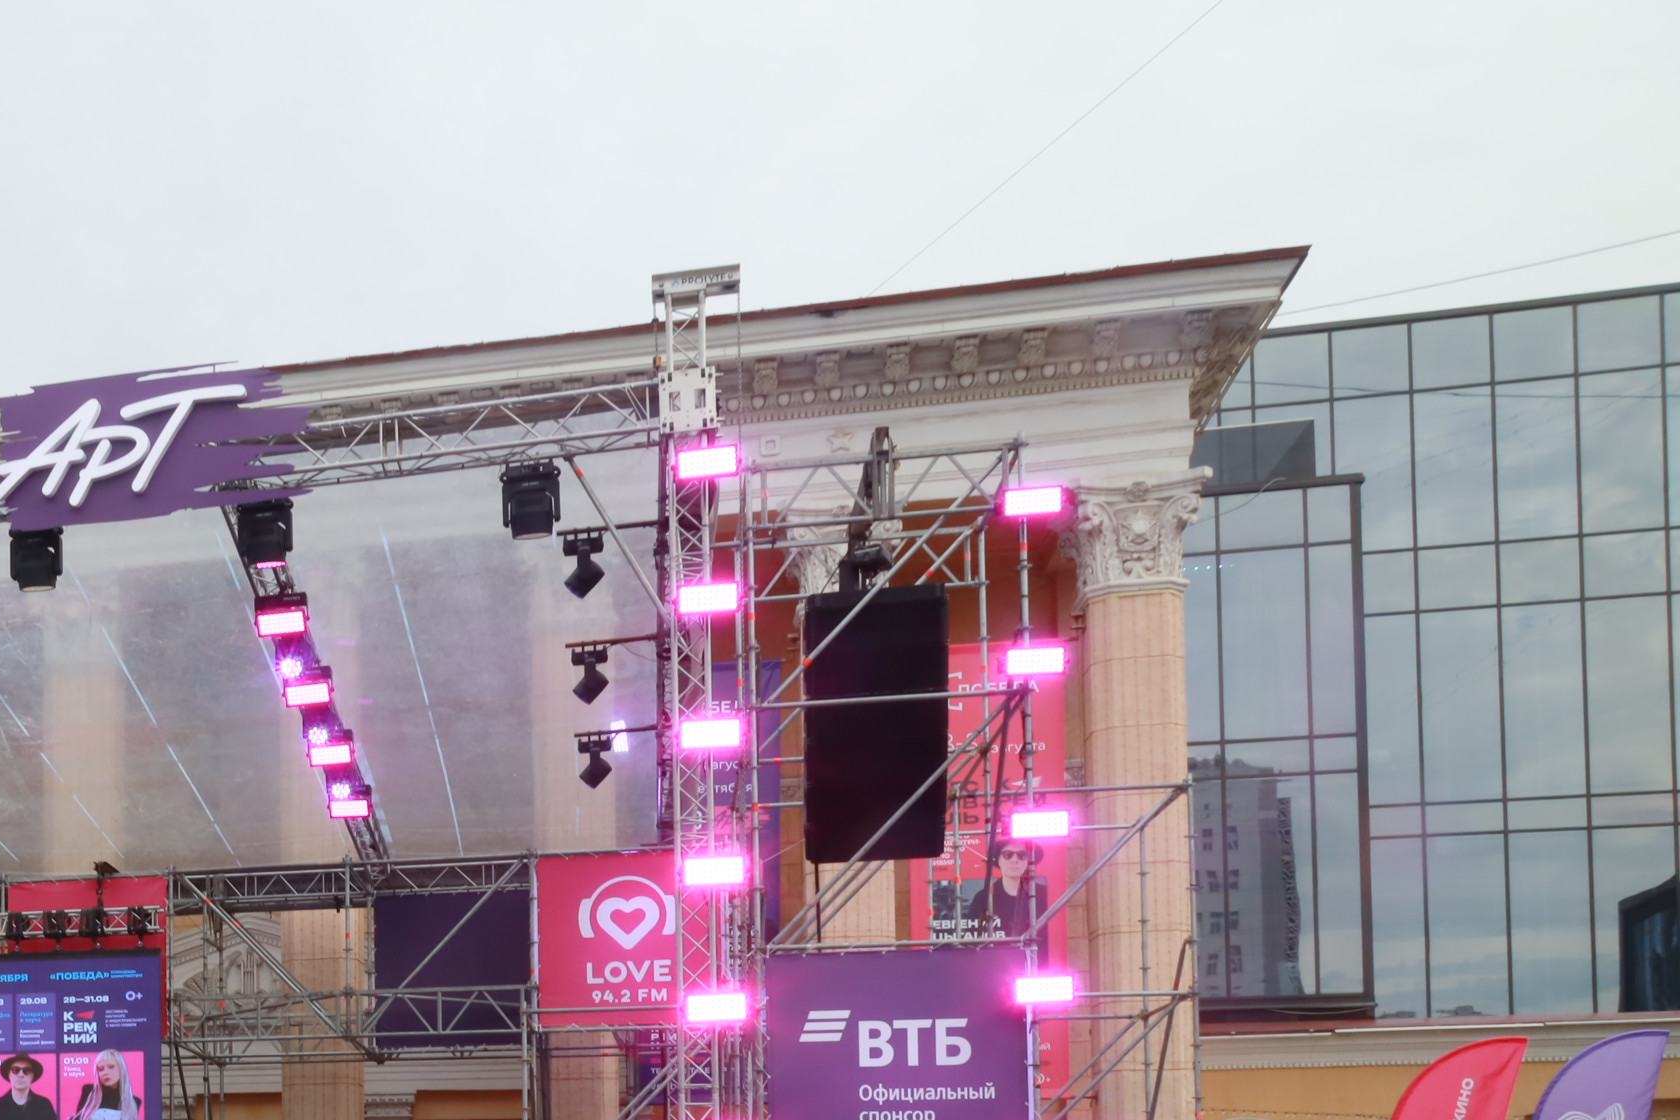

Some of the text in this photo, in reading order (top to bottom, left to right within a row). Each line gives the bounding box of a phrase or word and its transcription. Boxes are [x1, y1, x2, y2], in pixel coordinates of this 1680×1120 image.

[50, 970, 110, 981] «ПОБЕДА»
[586, 958, 672, 985] LOVE
[125, 991, 143, 1001] 0+
[592, 988, 668, 1003] 94.2 FM
[20, 997, 48, 1006] 29.08
[63, 1022, 97, 1033] РЕМ
[63, 1032, 97, 1044] НИЙ
[858, 1018, 972, 1067] ВТБ
[64, 1057, 89, 1065] 01.09
[858, 1081, 996, 1106] Официальный
